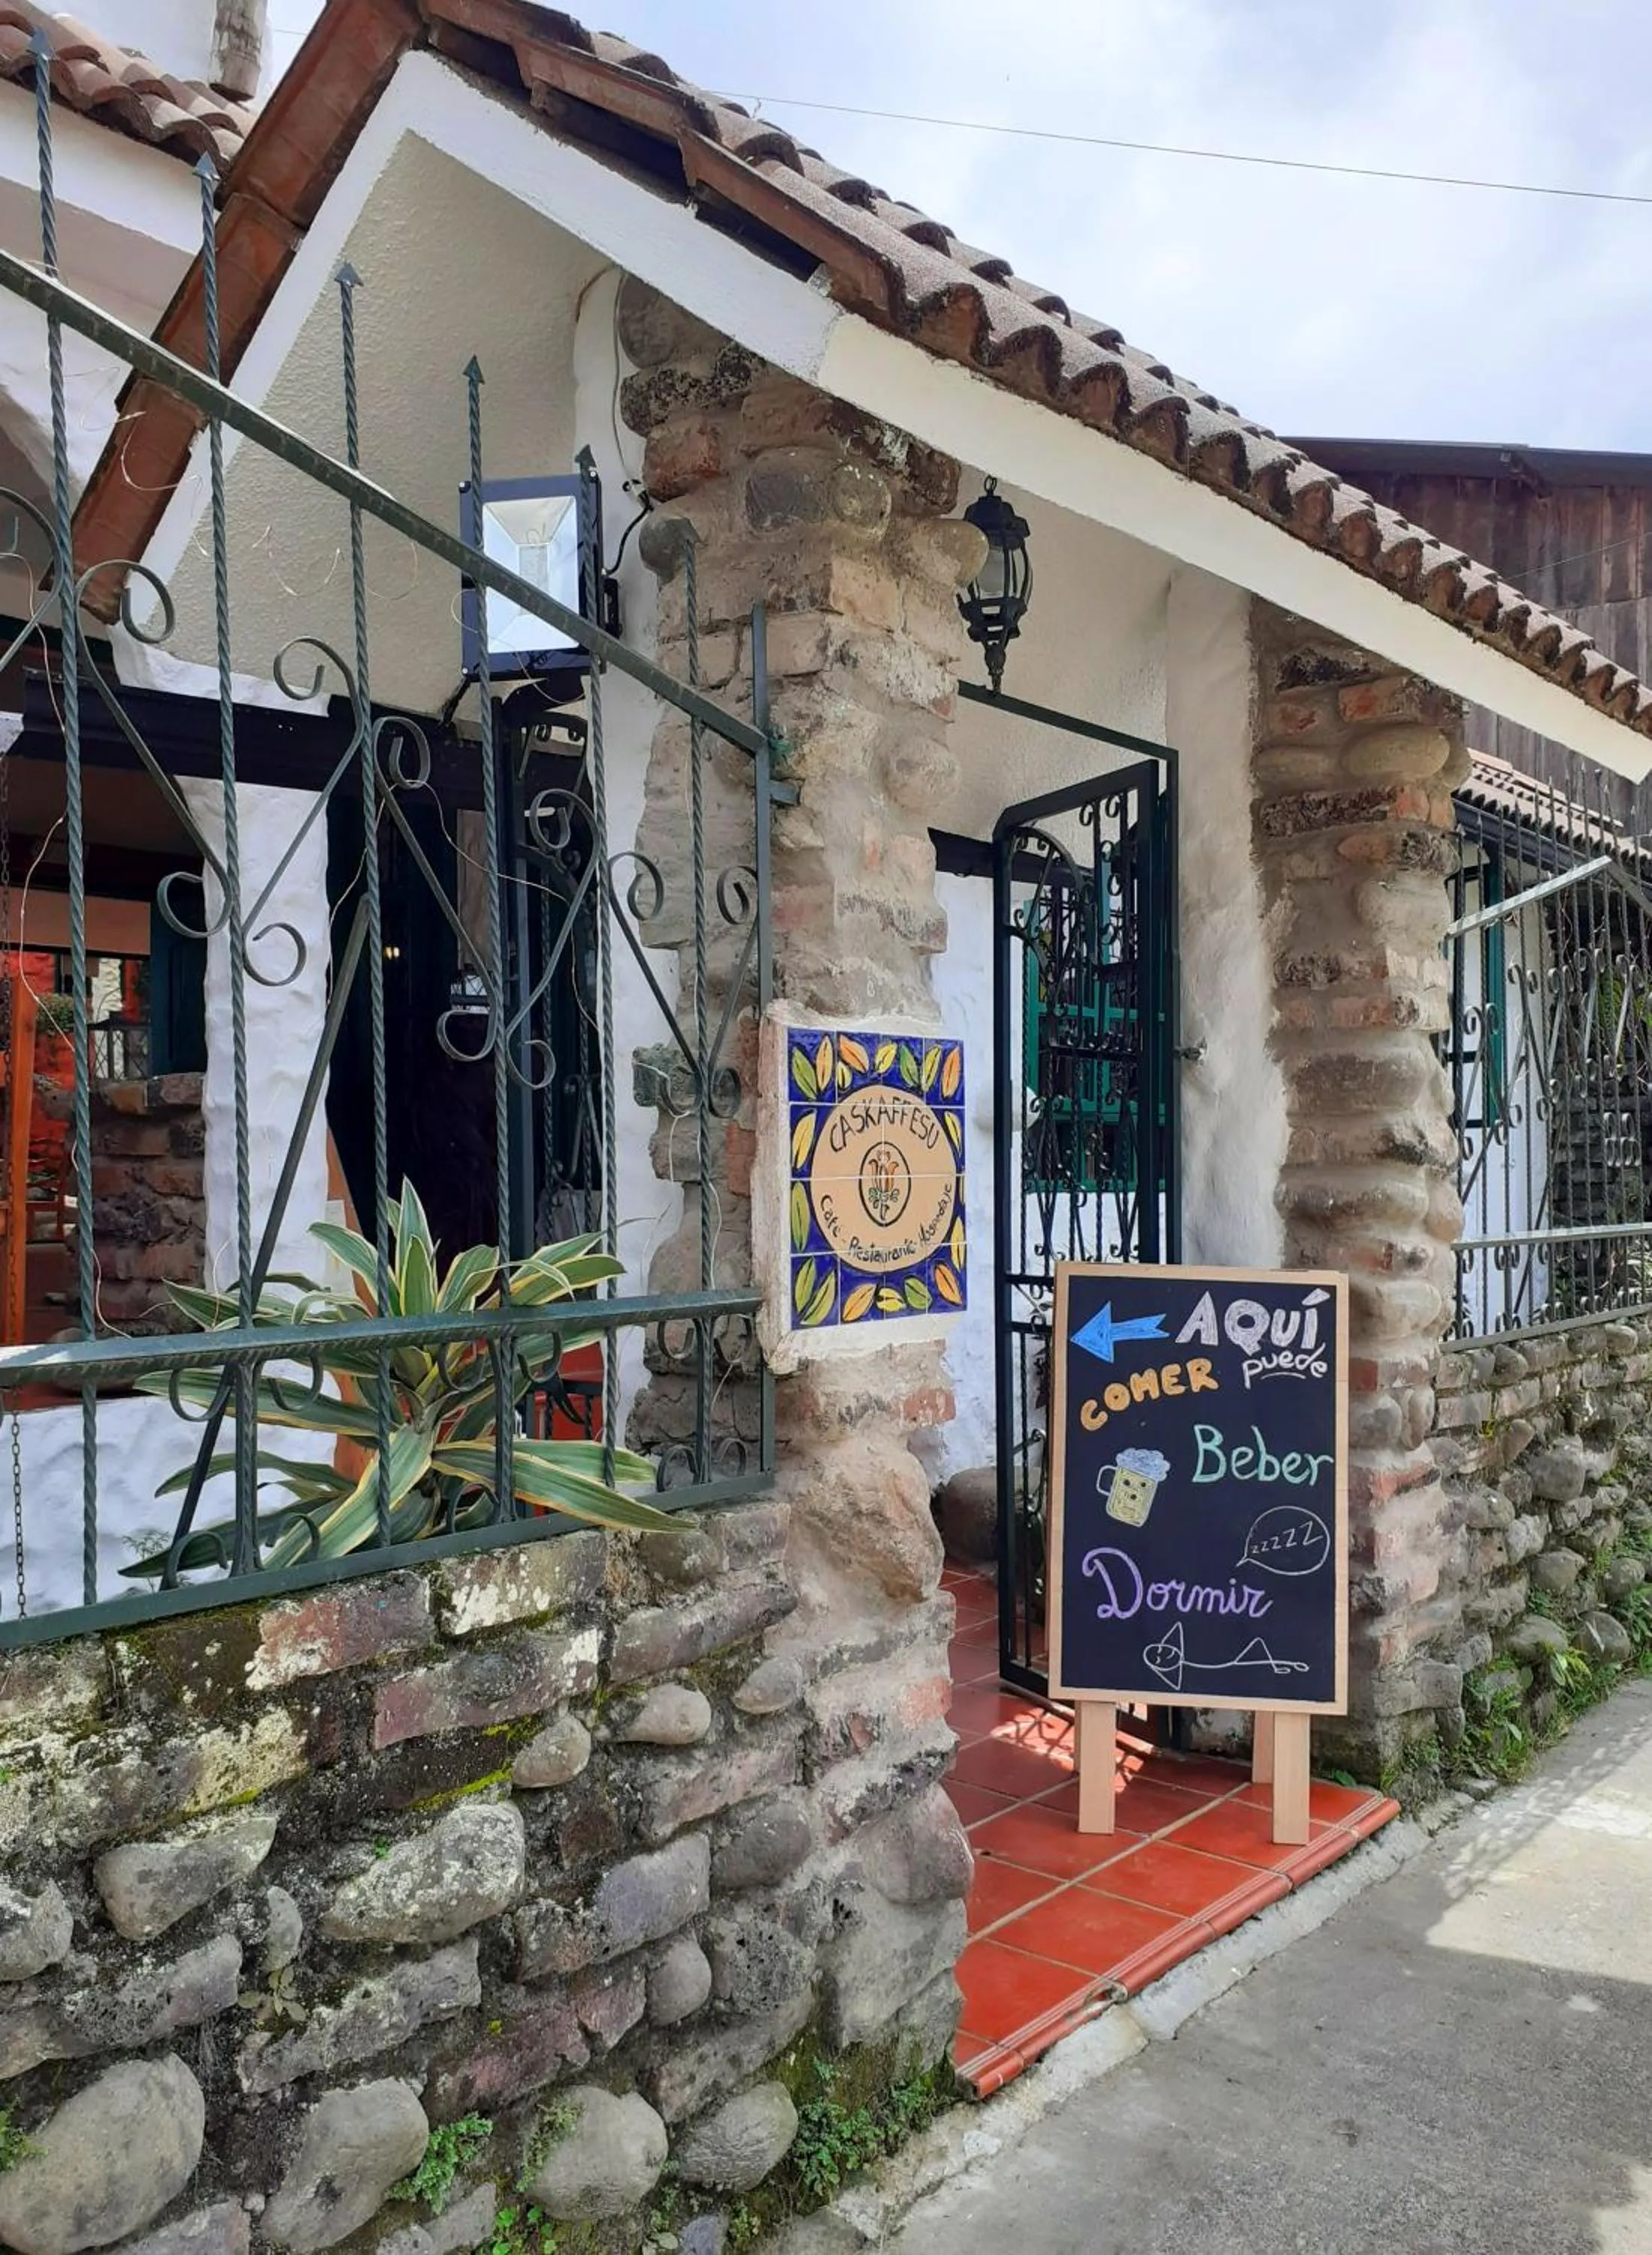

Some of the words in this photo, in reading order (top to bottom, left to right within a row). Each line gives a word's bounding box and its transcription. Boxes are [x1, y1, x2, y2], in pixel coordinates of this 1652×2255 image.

[830, 1094, 939, 1152] CASKAFFESU
[1175, 1288, 1330, 1355] AQUÍ
[1080, 1358, 1220, 1431] COMER
[1242, 1342, 1328, 1389] puede
[1191, 1424, 1334, 1485] Beber
[1082, 1547, 1274, 1619] Dormir
